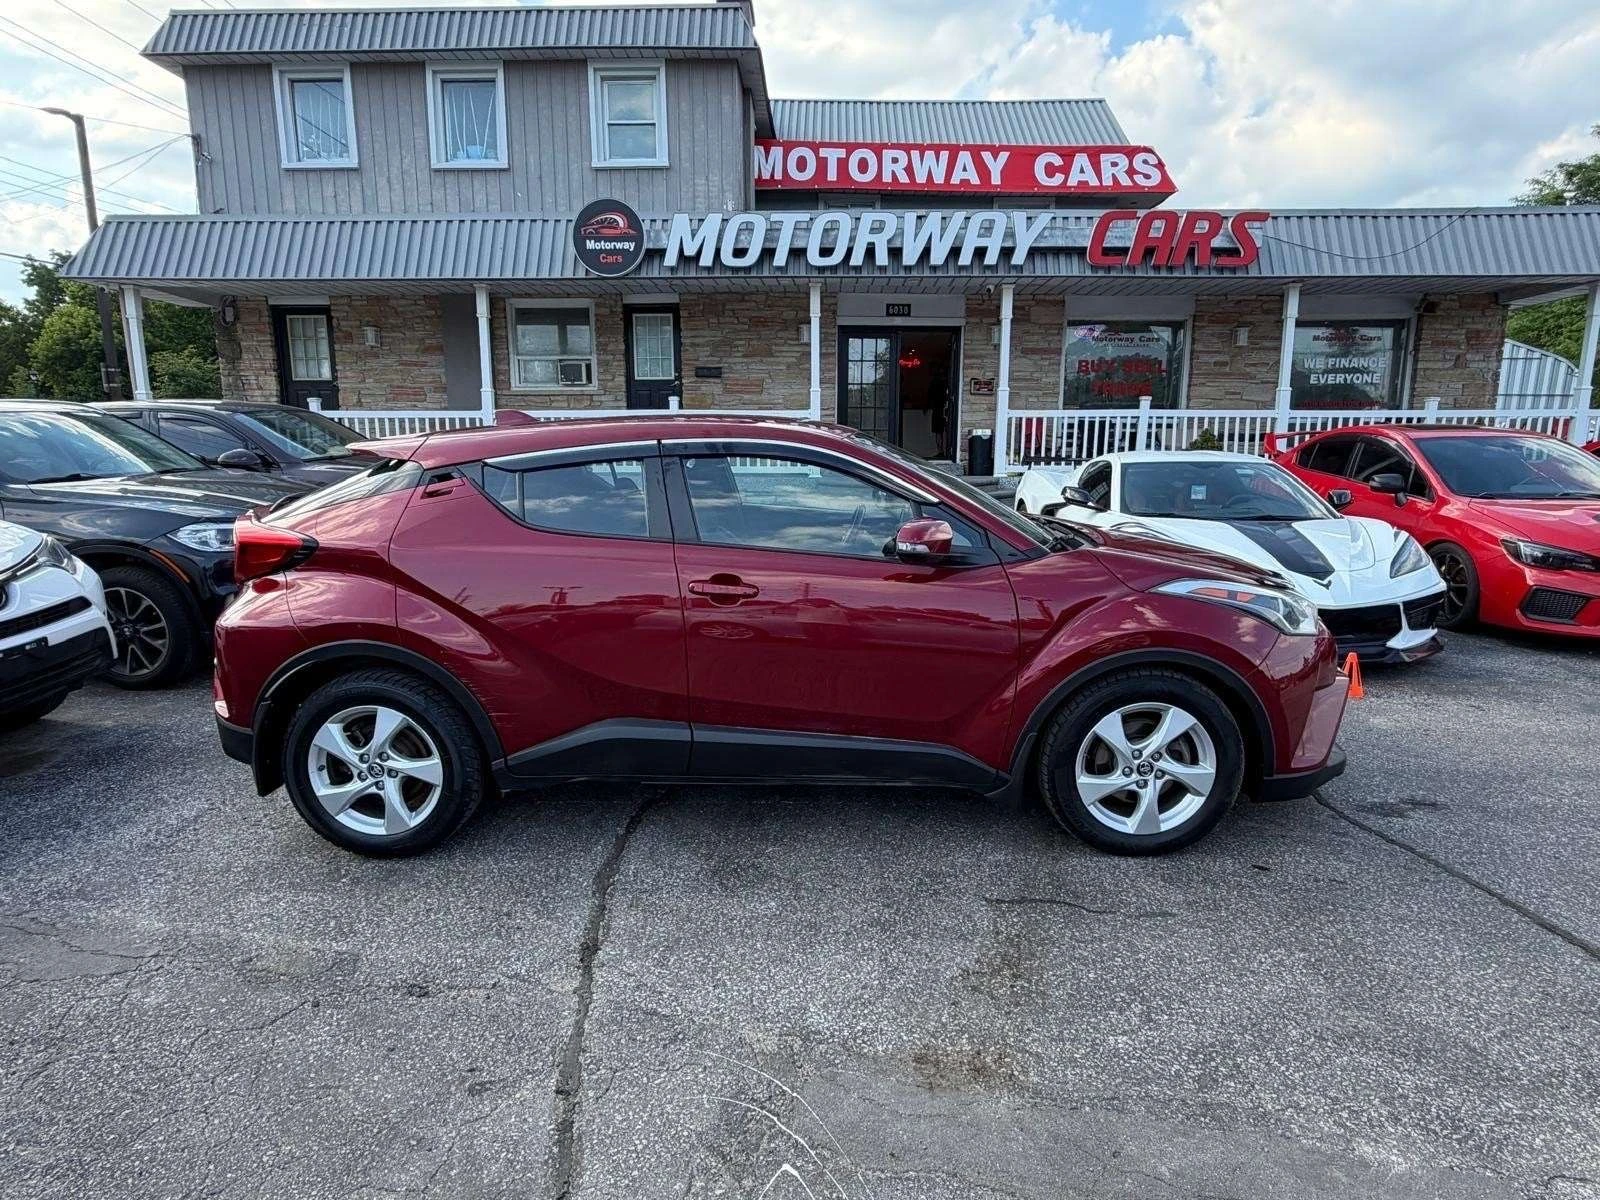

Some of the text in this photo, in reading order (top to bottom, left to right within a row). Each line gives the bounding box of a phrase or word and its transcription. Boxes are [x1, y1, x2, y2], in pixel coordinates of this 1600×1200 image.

[755, 145, 1163, 187] MOTORWAY CARS
[662, 209, 1271, 268] MOTORWAY CARS
[585, 239, 635, 252] Motorway
[599, 253, 623, 263] Cars
[1138, 335, 1161, 343] Cars
[1359, 334, 1382, 342] Cars
[1077, 359, 1117, 375] BUY
[1304, 357, 1388, 369] WE FINANCE
[1310, 373, 1381, 385] EVERYONE
